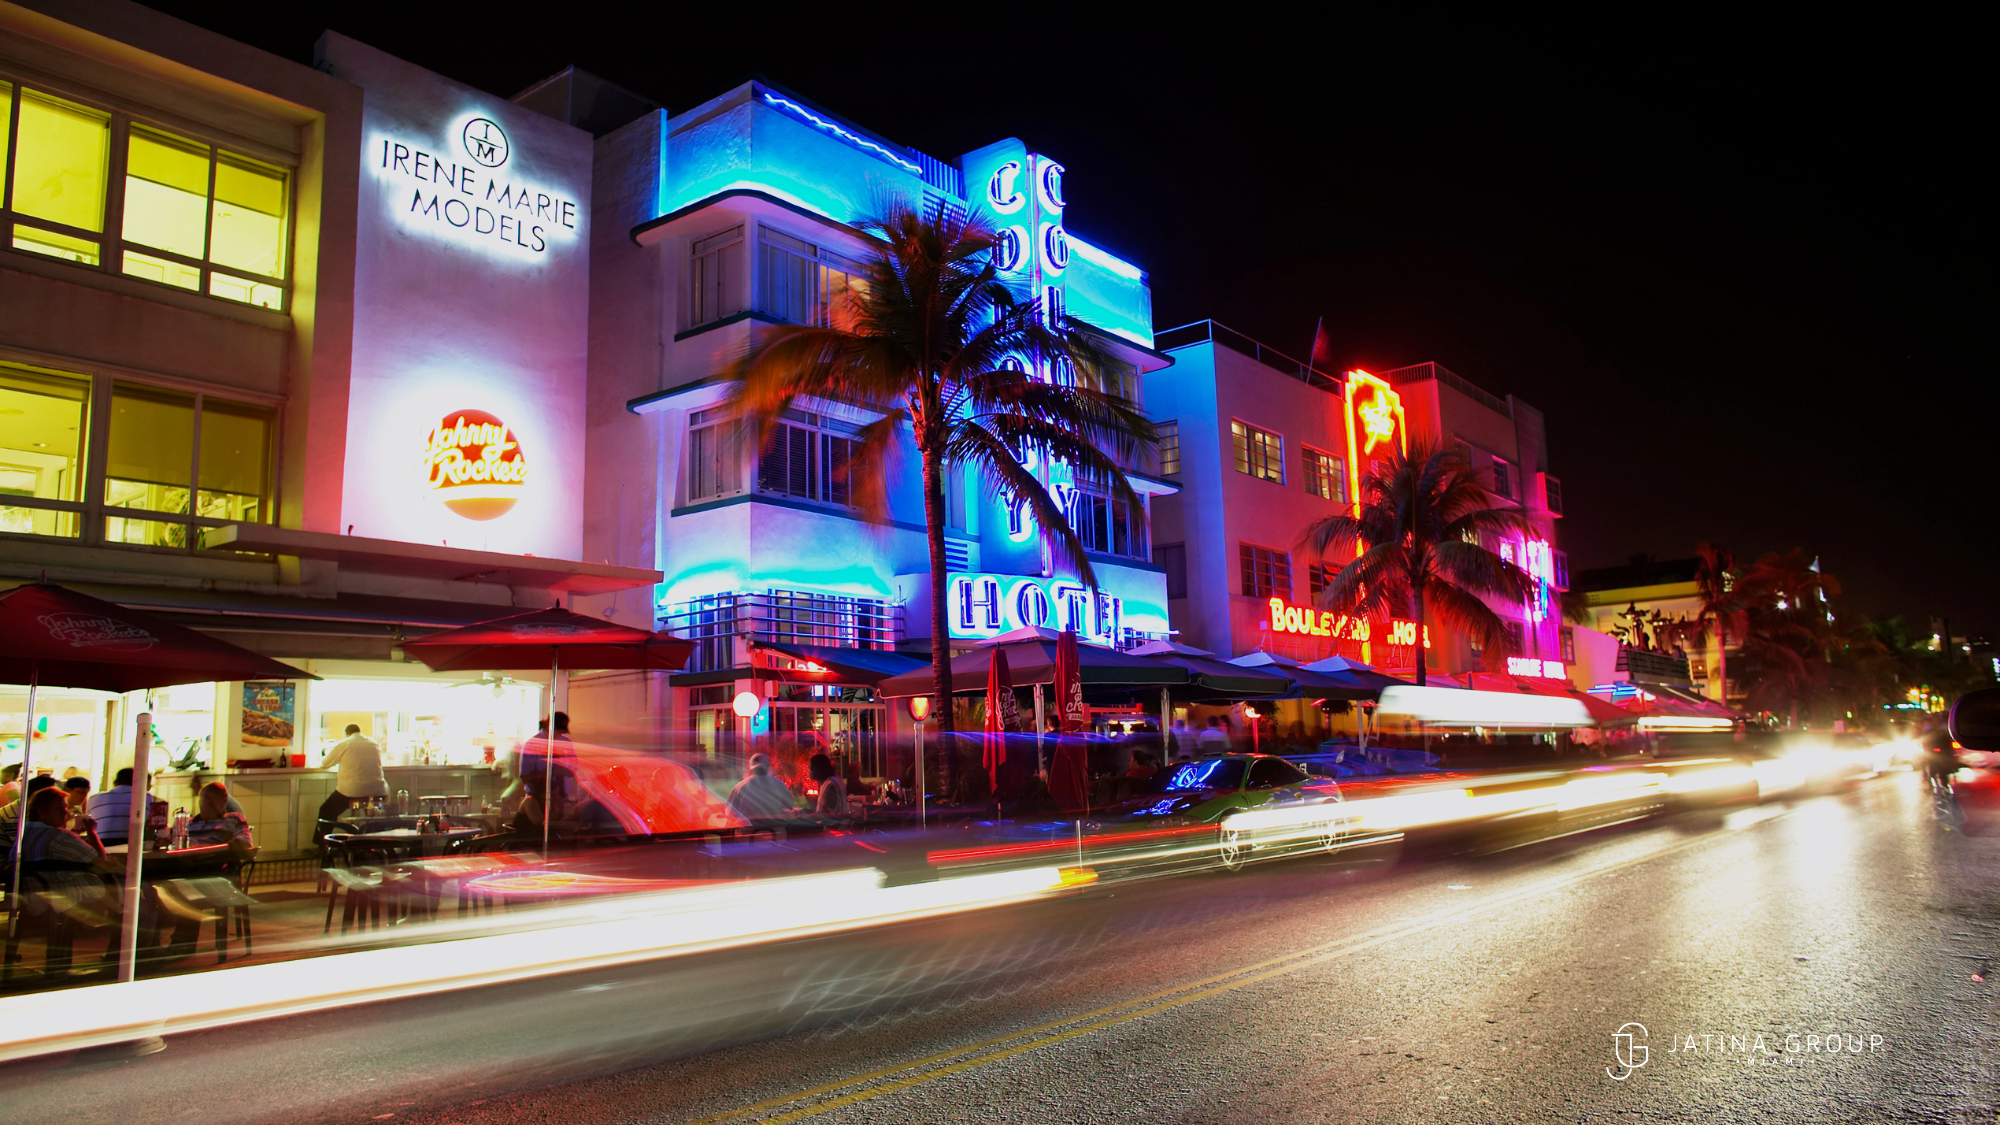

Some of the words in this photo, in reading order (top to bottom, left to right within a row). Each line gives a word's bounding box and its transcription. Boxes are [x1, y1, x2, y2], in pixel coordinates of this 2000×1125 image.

[382, 139, 475, 196] IRENE
[486, 178, 576, 229] MARIE
[410, 188, 546, 252] MODELS
[1043, 163, 1081, 531] COLOY
[37, 614, 126, 641] Johnny
[1269, 597, 1371, 642] BOULEVRD
